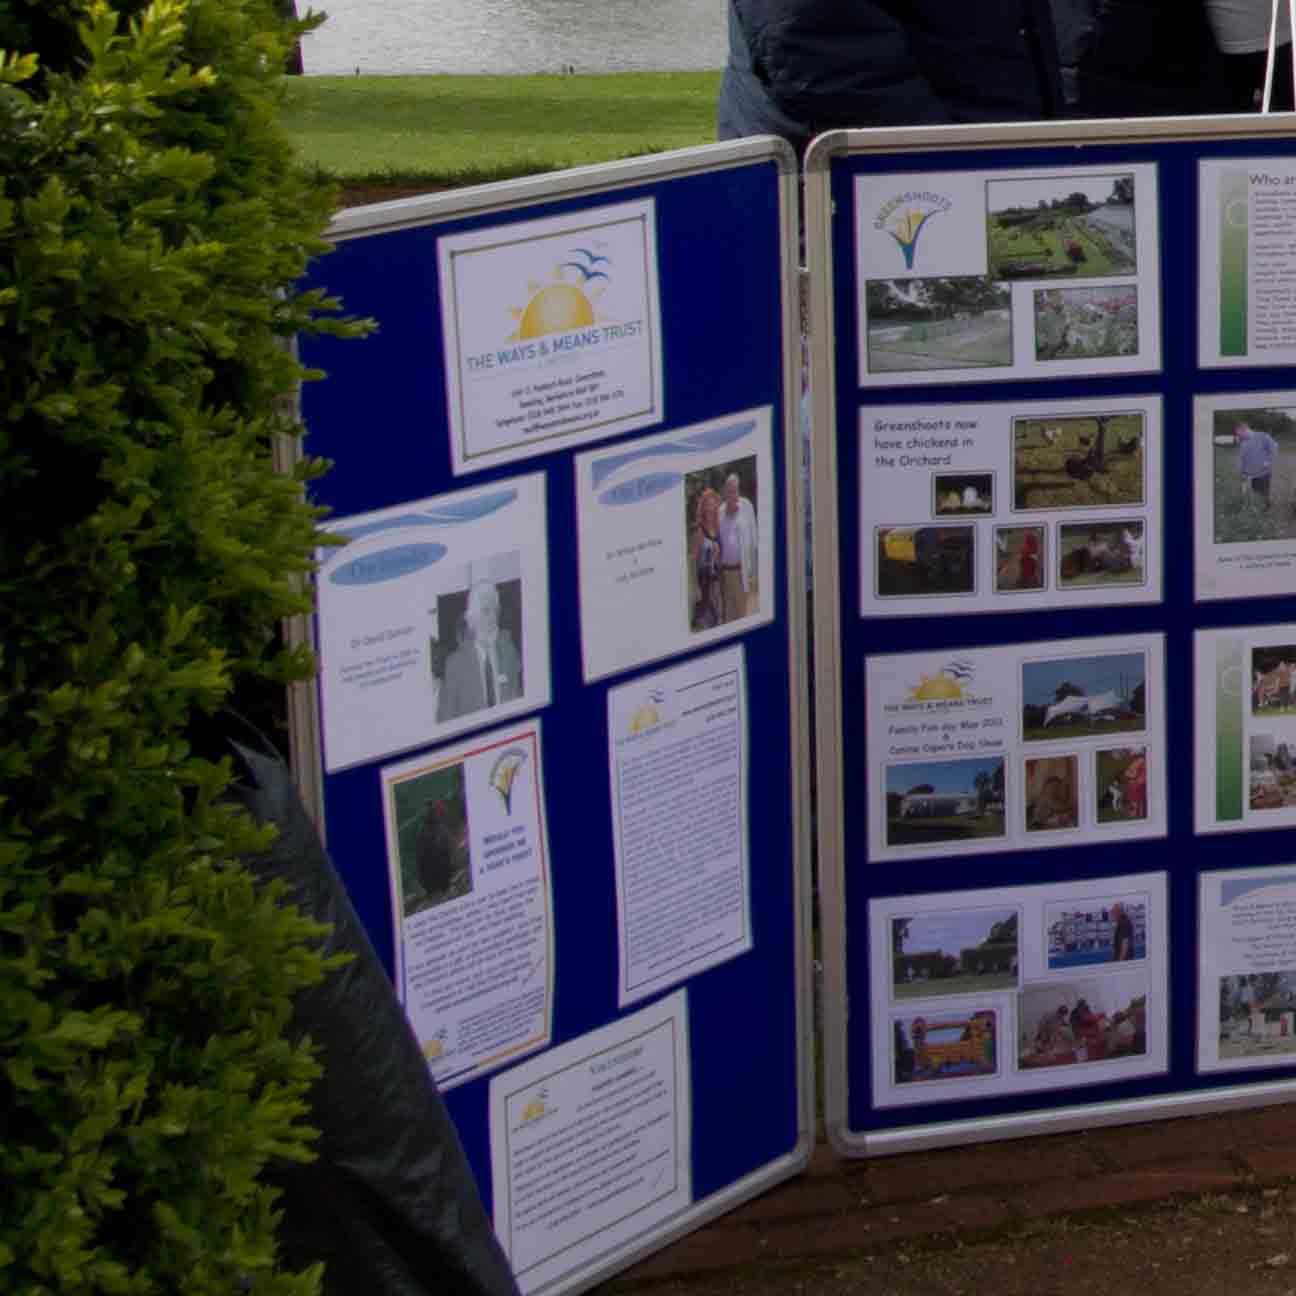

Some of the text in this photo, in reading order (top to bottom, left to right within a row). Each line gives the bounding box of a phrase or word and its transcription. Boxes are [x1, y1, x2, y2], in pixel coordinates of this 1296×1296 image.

[1249, 173, 1280, 185] Who
[466, 320, 643, 370] THE WAYS & MEANS TRUST
[874, 419, 978, 432] Greenshoots now
[874, 436, 974, 449] have chickens in
[875, 453, 951, 466] the Orchard
